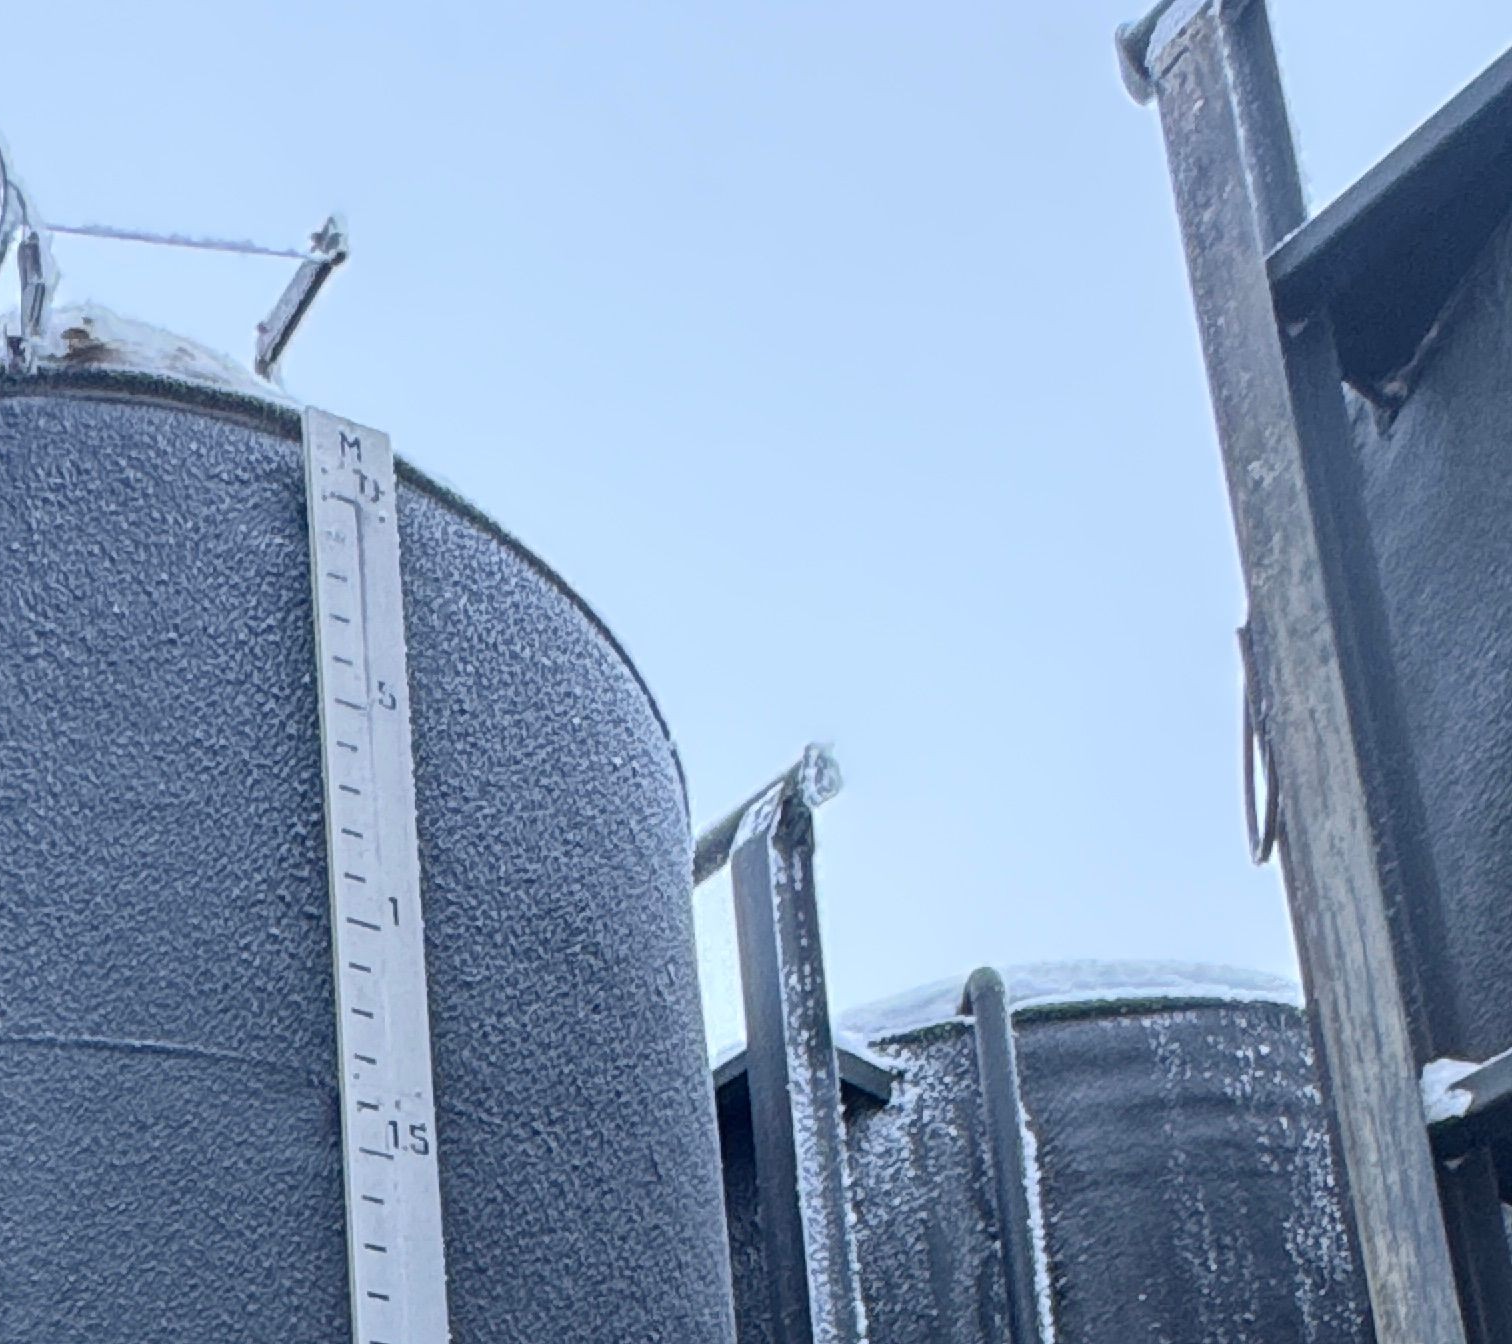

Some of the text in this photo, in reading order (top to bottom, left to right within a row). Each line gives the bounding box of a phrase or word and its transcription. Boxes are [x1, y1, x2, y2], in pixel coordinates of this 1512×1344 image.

[339, 430, 362, 464] M
[389, 896, 399, 926] 1
[388, 1119, 429, 1156] 1.5
